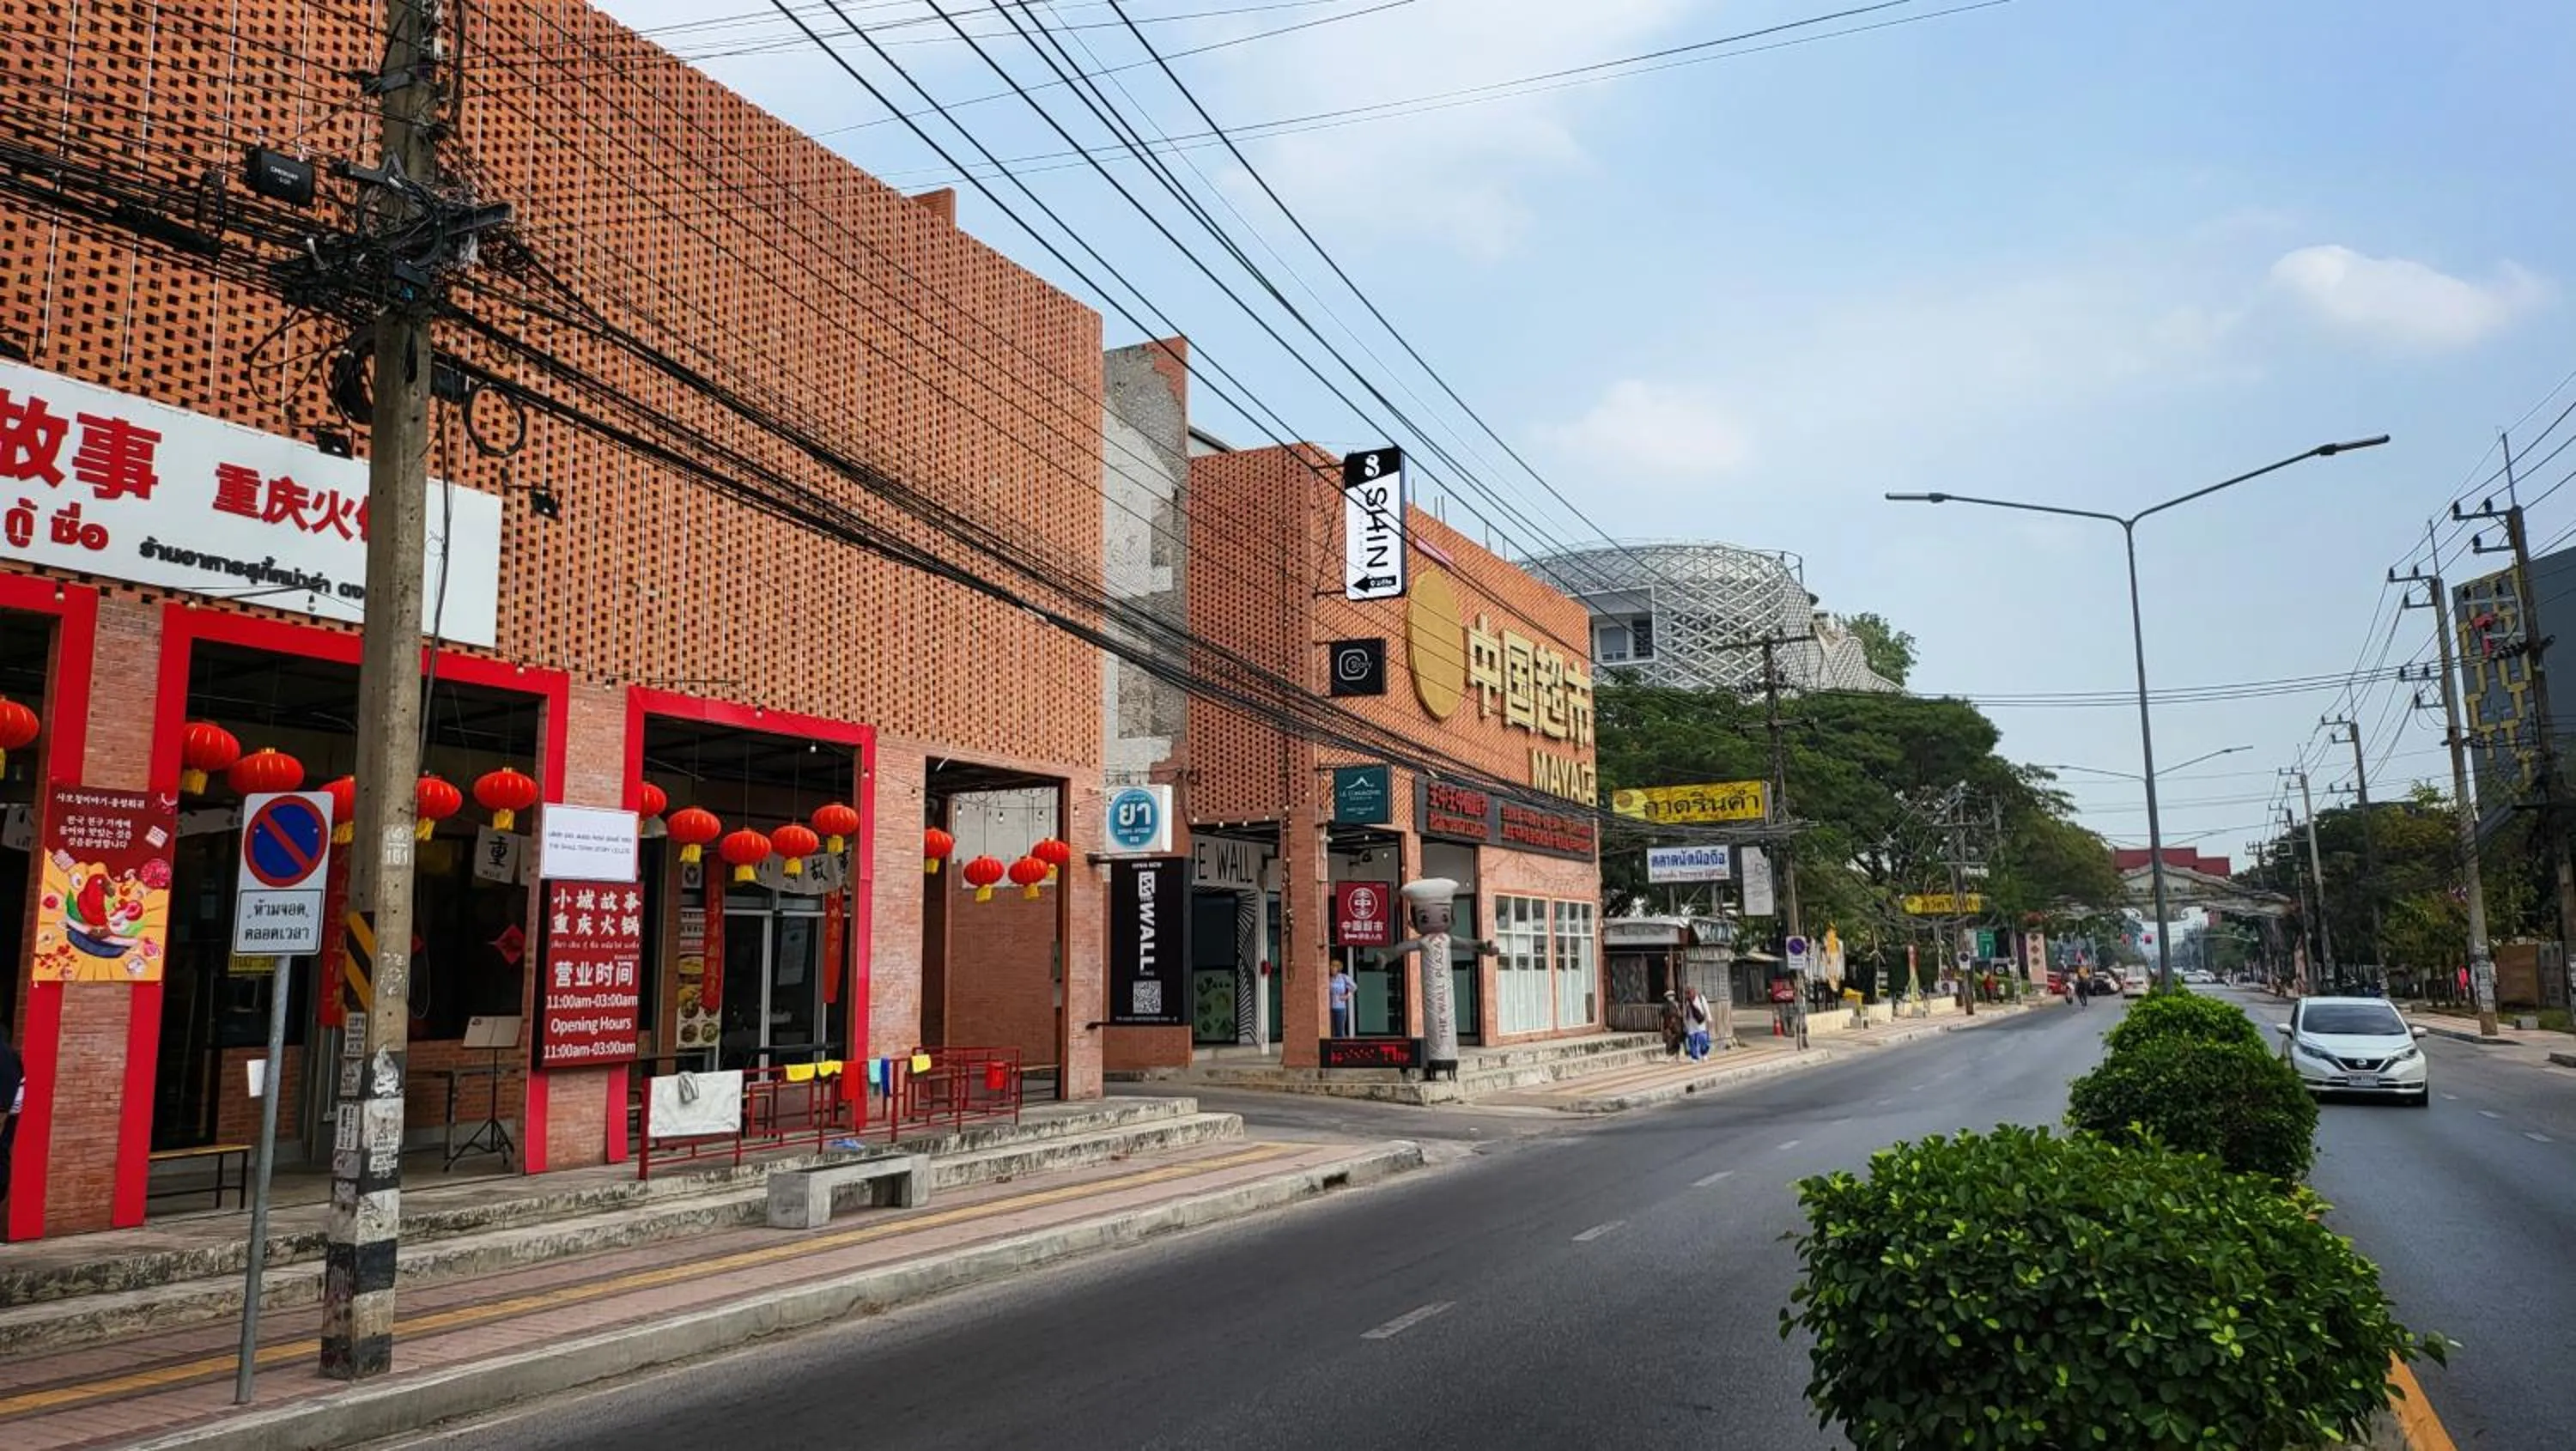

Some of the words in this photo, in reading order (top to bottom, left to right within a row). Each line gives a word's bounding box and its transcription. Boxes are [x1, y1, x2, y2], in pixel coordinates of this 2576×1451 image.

[0, 388, 161, 500] 故事
[1467, 613, 1593, 749] 中国超市
[1119, 803, 1151, 826] ยา
[1215, 841, 1253, 883] WALL
[254, 898, 307, 916] ห้ามจอด
[552, 888, 641, 913] 小城故事
[245, 927, 310, 941] ตลอดเวลา
[1139, 902, 1155, 971] WALL
[554, 960, 634, 987] 营业时间
[546, 993, 638, 1009] 11:00am-03:00am
[550, 1015, 598, 1035] Opening
[599, 1015, 631, 1029] Hours
[544, 1041, 636, 1059] 11:00am-03:00am
